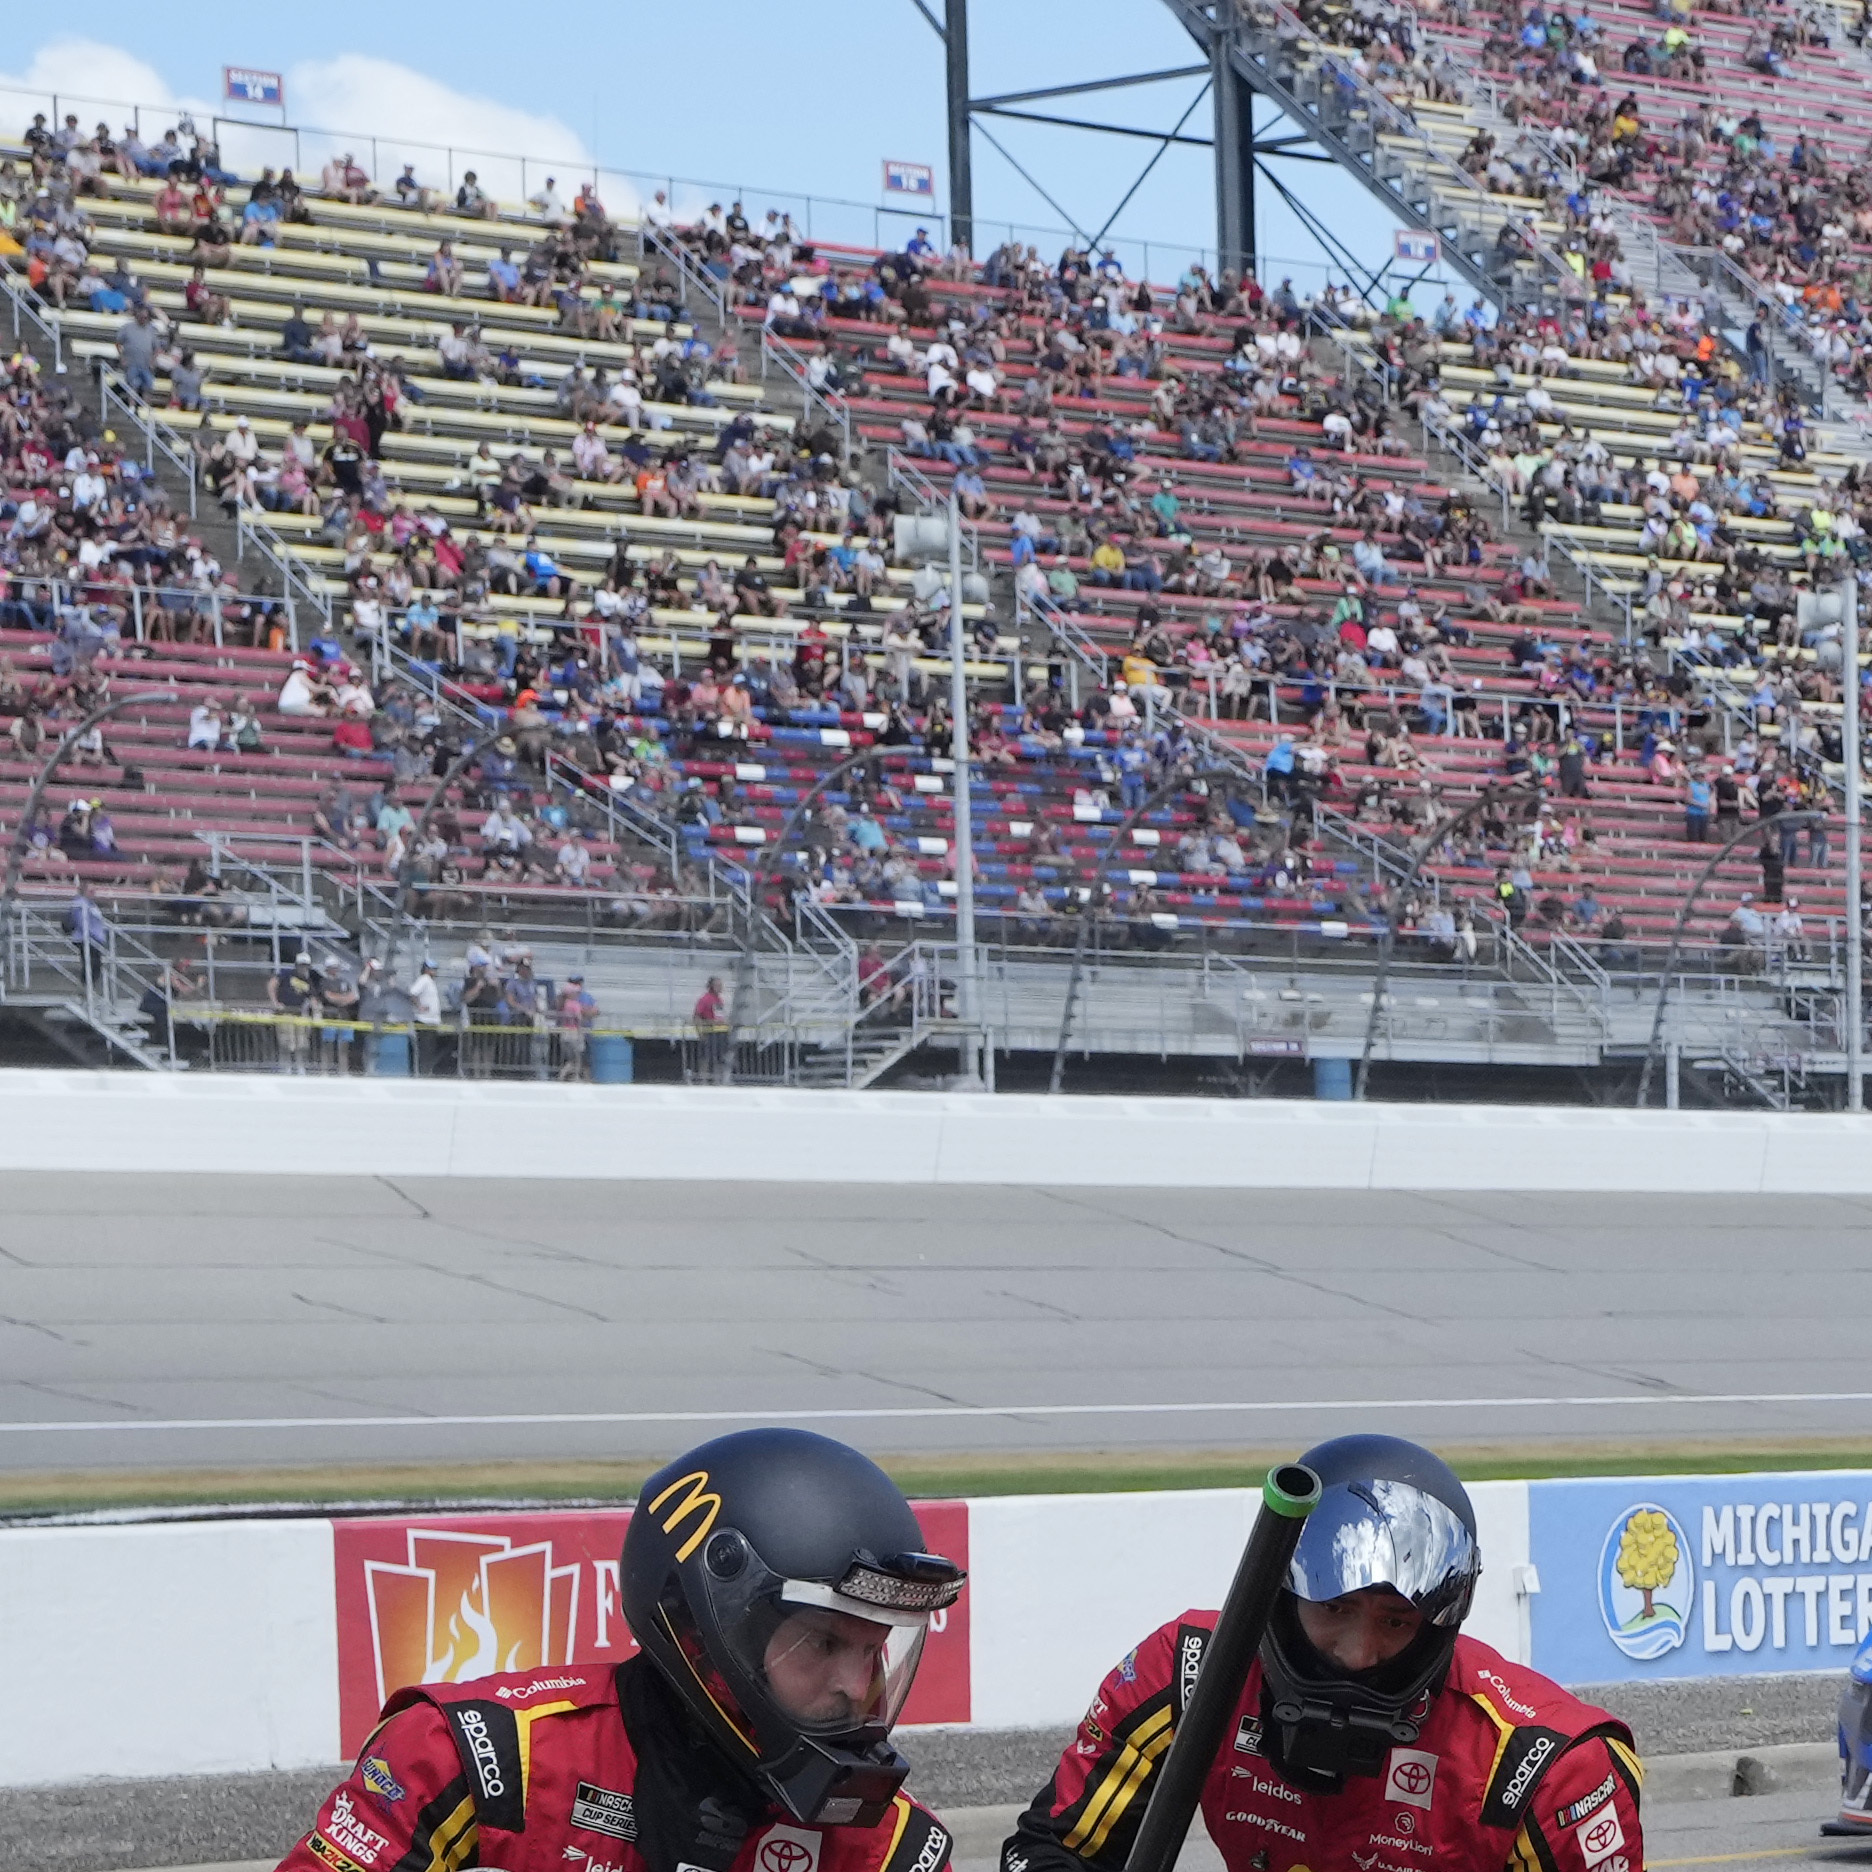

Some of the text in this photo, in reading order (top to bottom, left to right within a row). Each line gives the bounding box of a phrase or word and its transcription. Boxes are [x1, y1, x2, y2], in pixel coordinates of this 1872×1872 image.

[512, 1674, 587, 1701] Columbia
[1181, 1635, 1203, 1706] spar
[1489, 1674, 1537, 1720] Columbia
[457, 1709, 505, 1800] sparco
[1502, 1737, 1555, 1810] sparco
[598, 1792, 634, 1813] NASC
[1252, 1776, 1303, 1806] leidos
[1574, 1774, 1617, 1821] NASCAR
[331, 1803, 390, 1852] DRAFT
[582, 1807, 603, 1823] CUP
[1225, 1810, 1307, 1843] GOODYEAR
[324, 1823, 378, 1865] KINGS
[1369, 1831, 1434, 1857] MoneyLion
